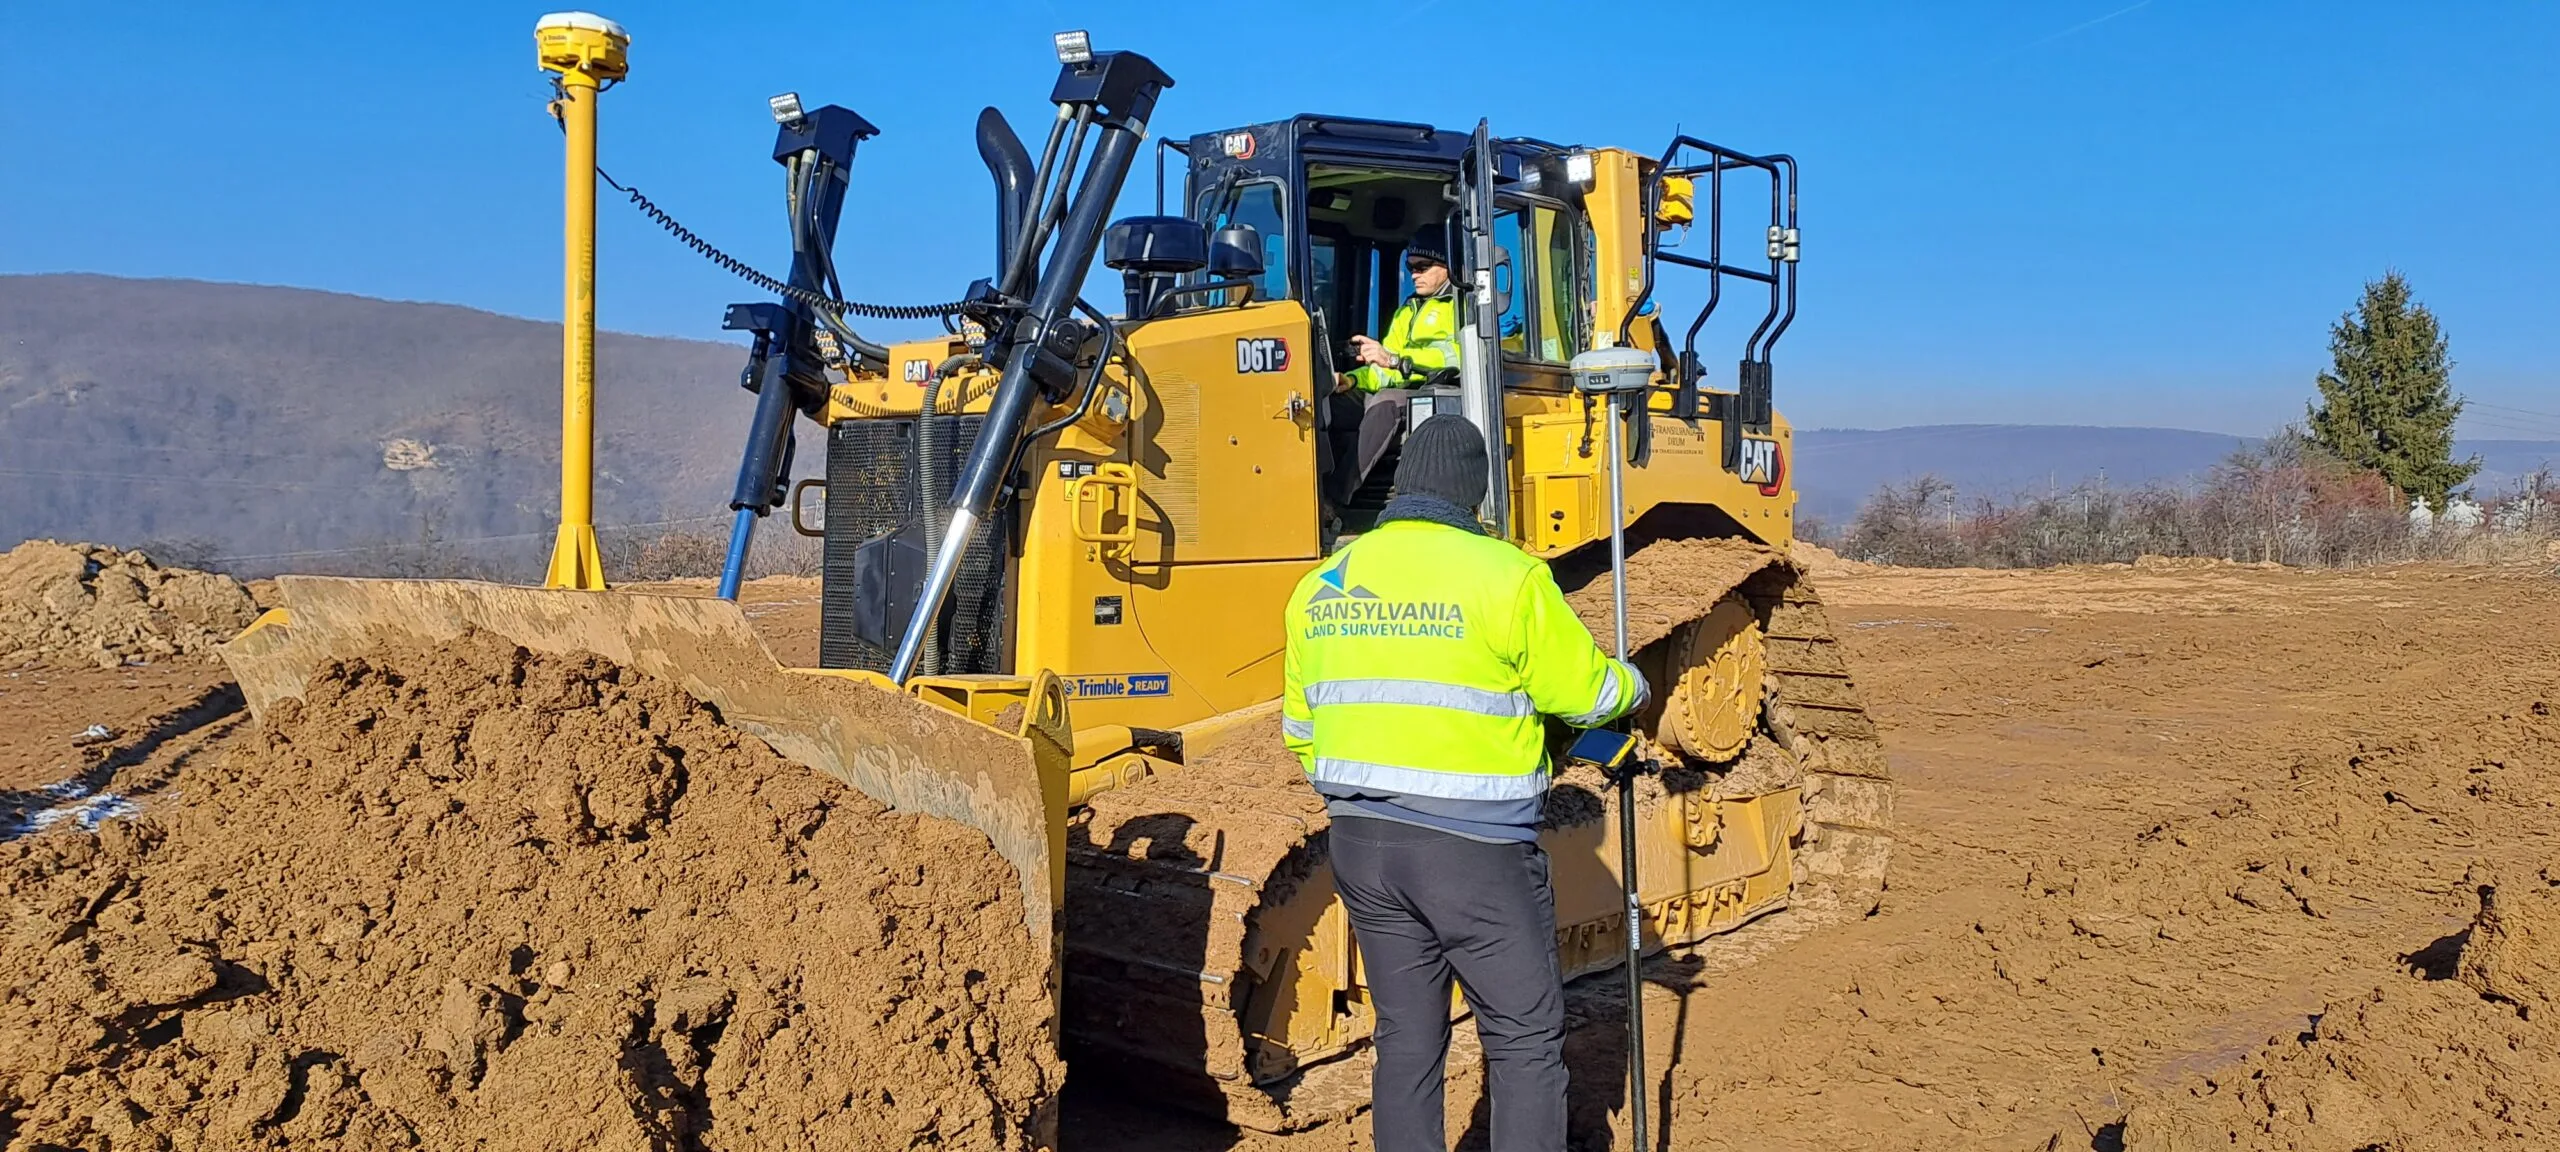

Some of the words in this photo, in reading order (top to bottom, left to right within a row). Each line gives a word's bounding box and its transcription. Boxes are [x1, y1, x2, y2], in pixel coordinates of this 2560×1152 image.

[1224, 134, 1248, 157] CAT
[1408, 246, 1446, 260] olumbia
[576, 311, 592, 385] Trimble
[1237, 339, 1275, 372] D6T
[904, 360, 929, 381] CAT
[1741, 438, 1775, 484] CAT
[1304, 602, 1465, 624] TRANSYLVANIA
[1305, 624, 1337, 640] LAND
[1340, 623, 1465, 639] SURVEYLLANCE
[1077, 678, 1125, 697] Trimble
[1134, 680, 1167, 692] READY
